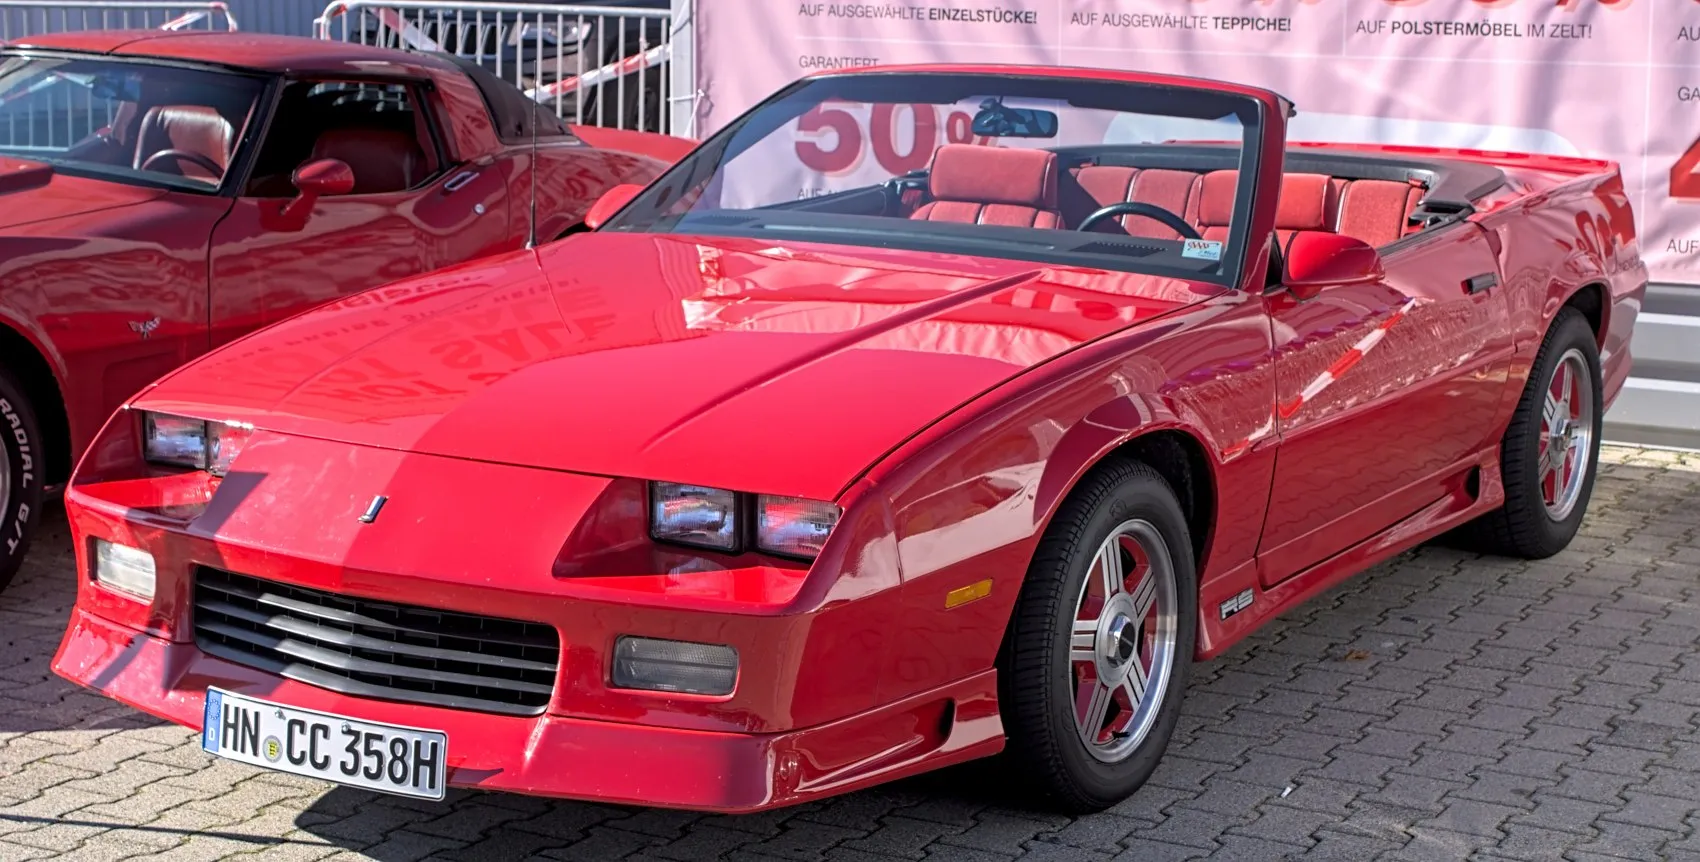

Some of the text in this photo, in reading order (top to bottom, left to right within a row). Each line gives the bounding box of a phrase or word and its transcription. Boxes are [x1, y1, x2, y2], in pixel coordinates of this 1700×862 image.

[798, 4, 1037, 24] AUF AUSGEWÄHLTE EINZELSTÜCKE!
[1071, 12, 1291, 31] AUF AUSGEWÄHLTE TEPPICHE!
[1356, 19, 1592, 39] AUF POLSTERMÖBEL IM ZELT!
[1666, 238, 1700, 255] AUF
[0, 397, 34, 489] RADIAL
[7, 502, 30, 556] G/T
[222, 703, 438, 790] HN CC 358H
